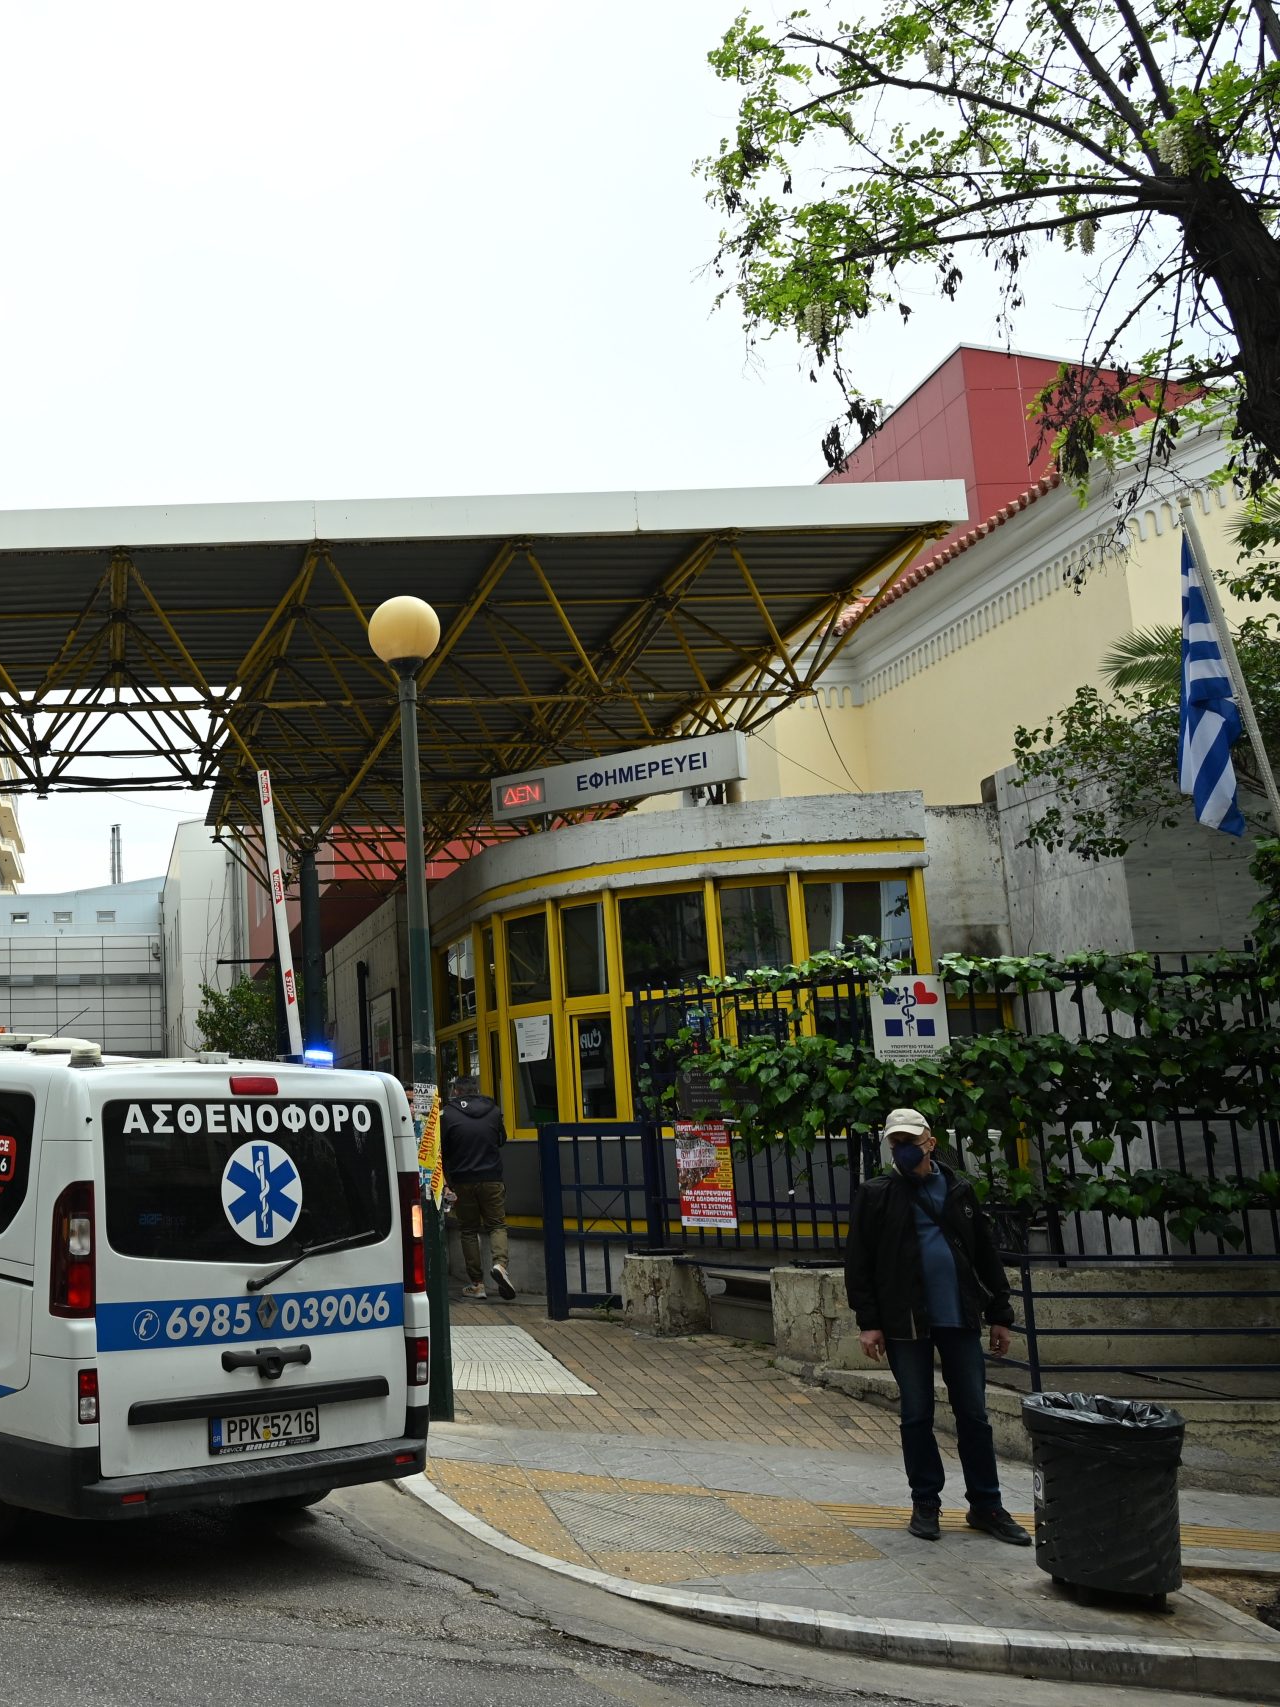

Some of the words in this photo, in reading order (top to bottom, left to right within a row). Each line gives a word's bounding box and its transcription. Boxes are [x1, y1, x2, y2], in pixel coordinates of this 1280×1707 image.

[576, 751, 708, 792] ΕΦΗΜΕΡΕΥΕΙ
[503, 784, 540, 806] ΔΕΝ
[273, 873, 282, 900] Nicolis
[286, 976, 294, 998] STOP
[122, 1104, 372, 1134] ΑΣΘΕΝΟΦΟΡΟ
[166, 1302, 252, 1340] 6985
[281, 1291, 390, 1332] 039066
[219, 1446, 243, 1455] SERVICE
